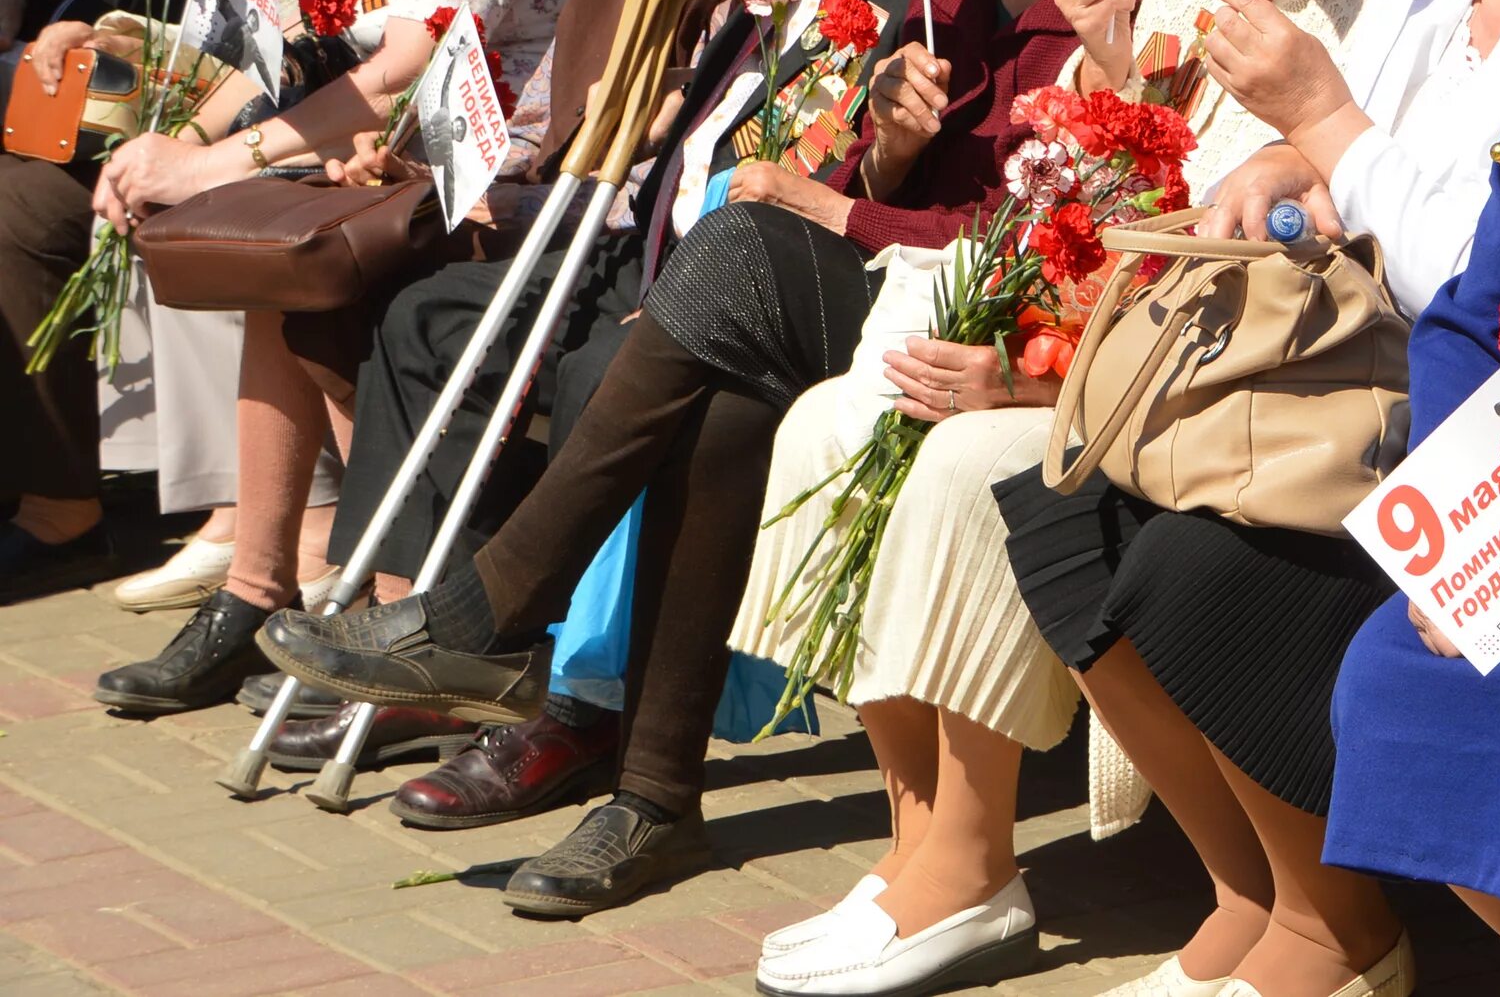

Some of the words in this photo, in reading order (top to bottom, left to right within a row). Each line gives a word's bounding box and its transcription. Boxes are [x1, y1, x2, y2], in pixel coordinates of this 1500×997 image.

[459, 79, 497, 172] ПОБЕДА
[467, 47, 507, 150] ВЕЛИКАЯ
[1377, 484, 1445, 576] 9
